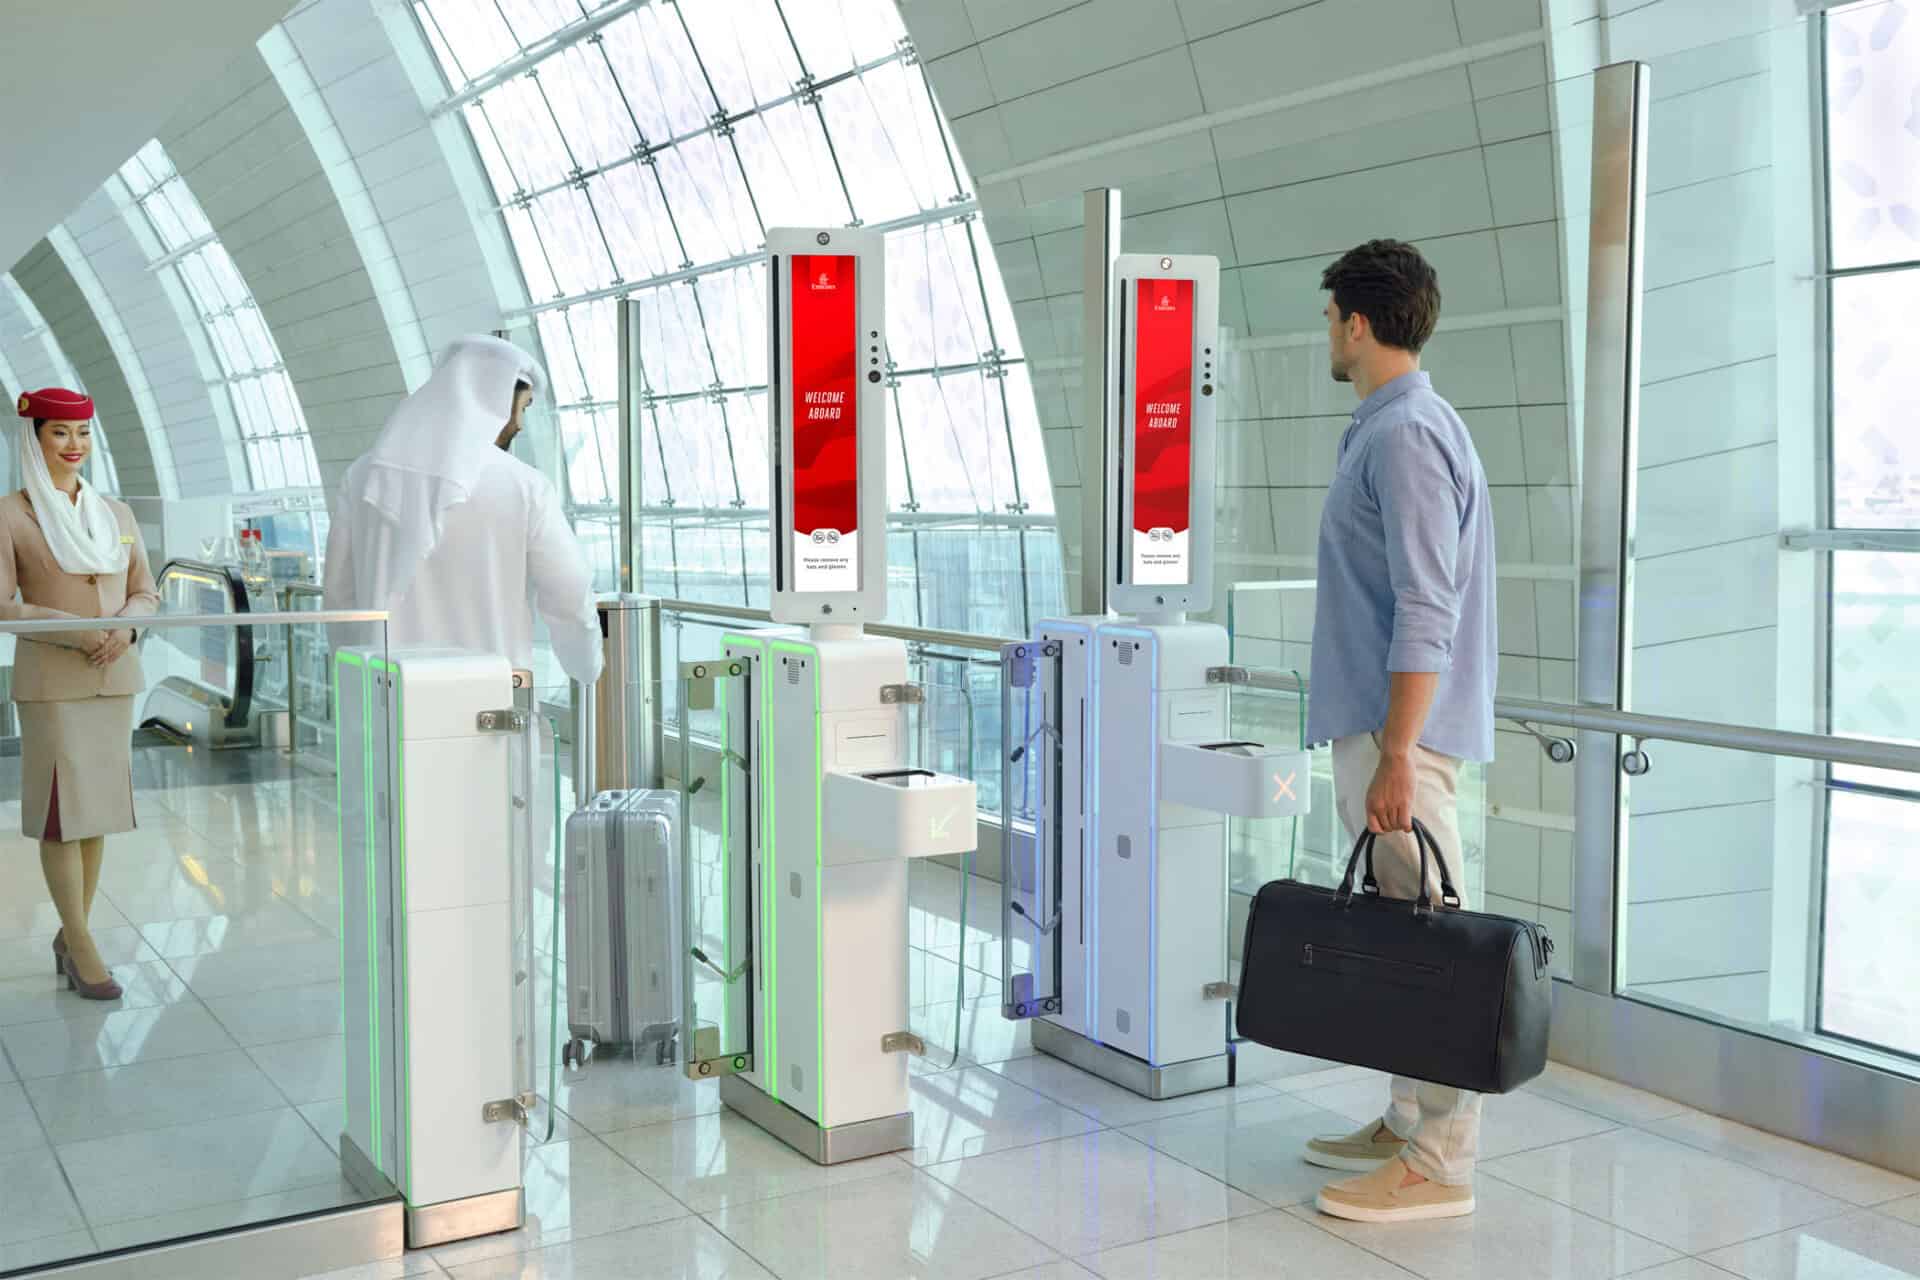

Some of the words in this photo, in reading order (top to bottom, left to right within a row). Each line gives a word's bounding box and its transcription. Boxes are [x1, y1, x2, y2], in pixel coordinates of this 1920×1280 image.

[804, 391, 845, 404] WELCOME
[808, 407, 841, 420] ABOARD
[1146, 402, 1181, 415] WELCOME
[1148, 417, 1178, 429] ABOARD
